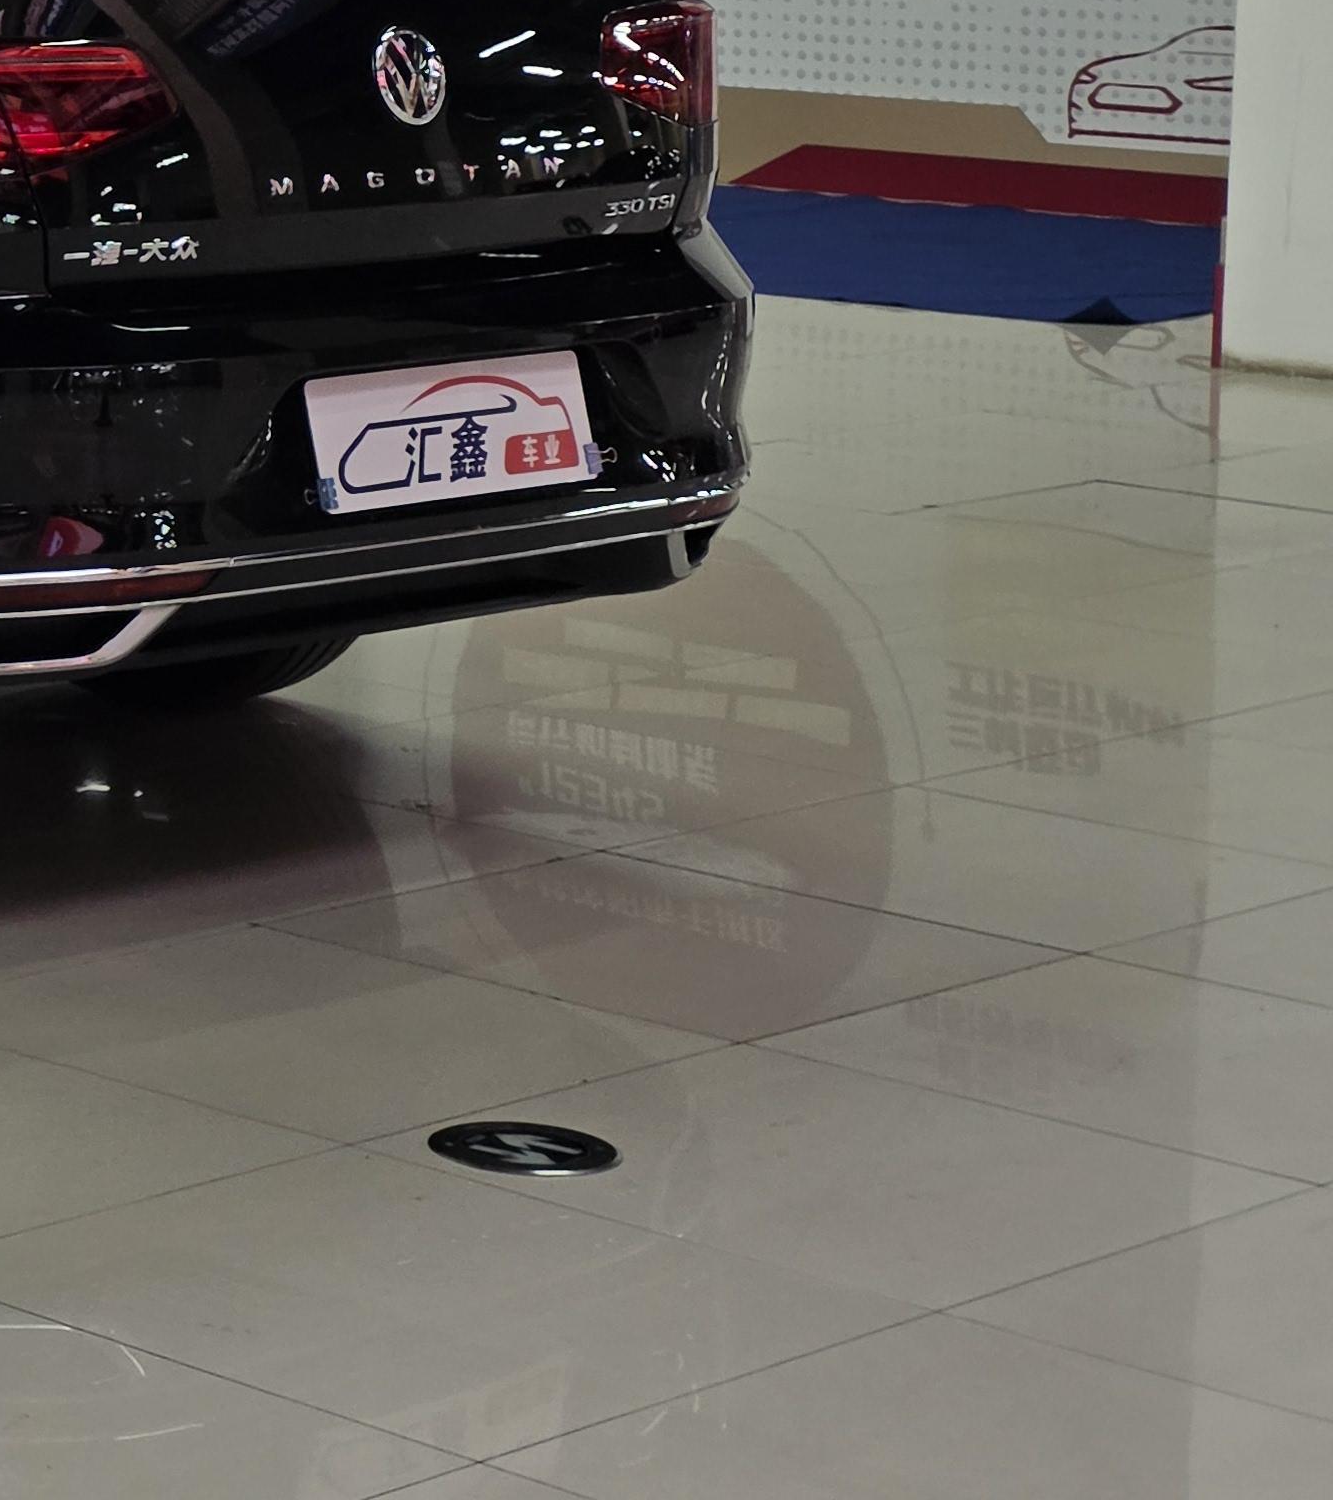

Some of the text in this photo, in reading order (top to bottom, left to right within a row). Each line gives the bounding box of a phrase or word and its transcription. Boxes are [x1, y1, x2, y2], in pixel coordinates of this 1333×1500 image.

[269, 156, 565, 198] MAGOTAN
[605, 192, 676, 219] 330 TSI
[405, 415, 489, 484] 汇鑫
[521, 434, 562, 468] 车业
